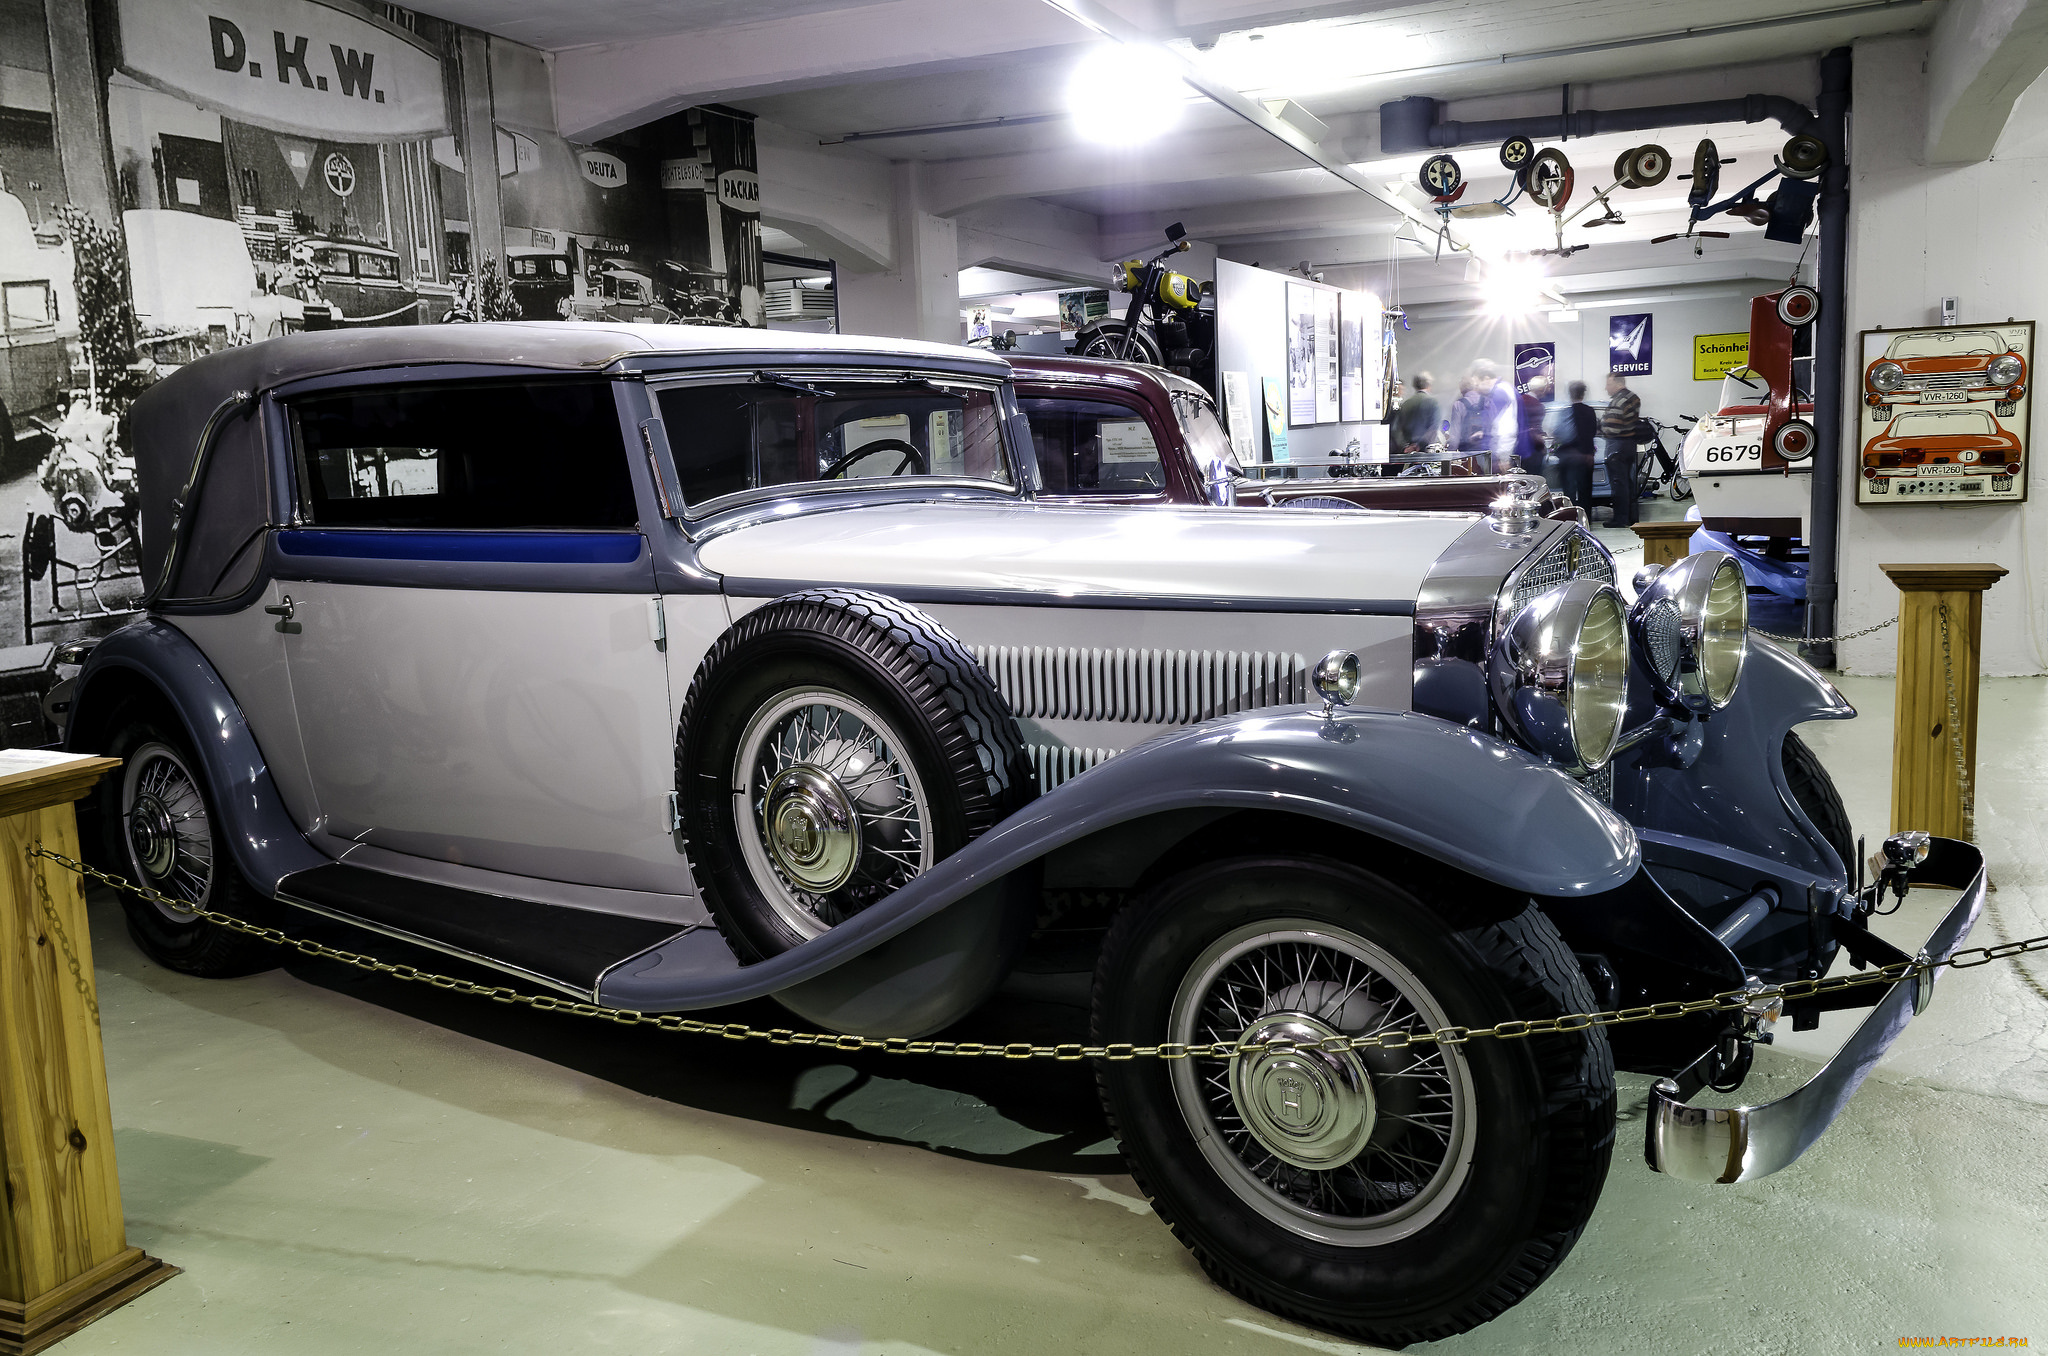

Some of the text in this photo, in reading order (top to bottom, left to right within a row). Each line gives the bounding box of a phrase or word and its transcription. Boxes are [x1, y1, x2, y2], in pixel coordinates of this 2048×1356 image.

[208, 15, 386, 104] D.K.W.
[586, 160, 618, 180] DEUTA
[1612, 362, 1649, 373] SERVICE
[1923, 391, 1964, 401] VVR-1260
[1706, 444, 1761, 463] 6679
[1965, 451, 1974, 461] D
[1920, 465, 1961, 475] VVR-1260
